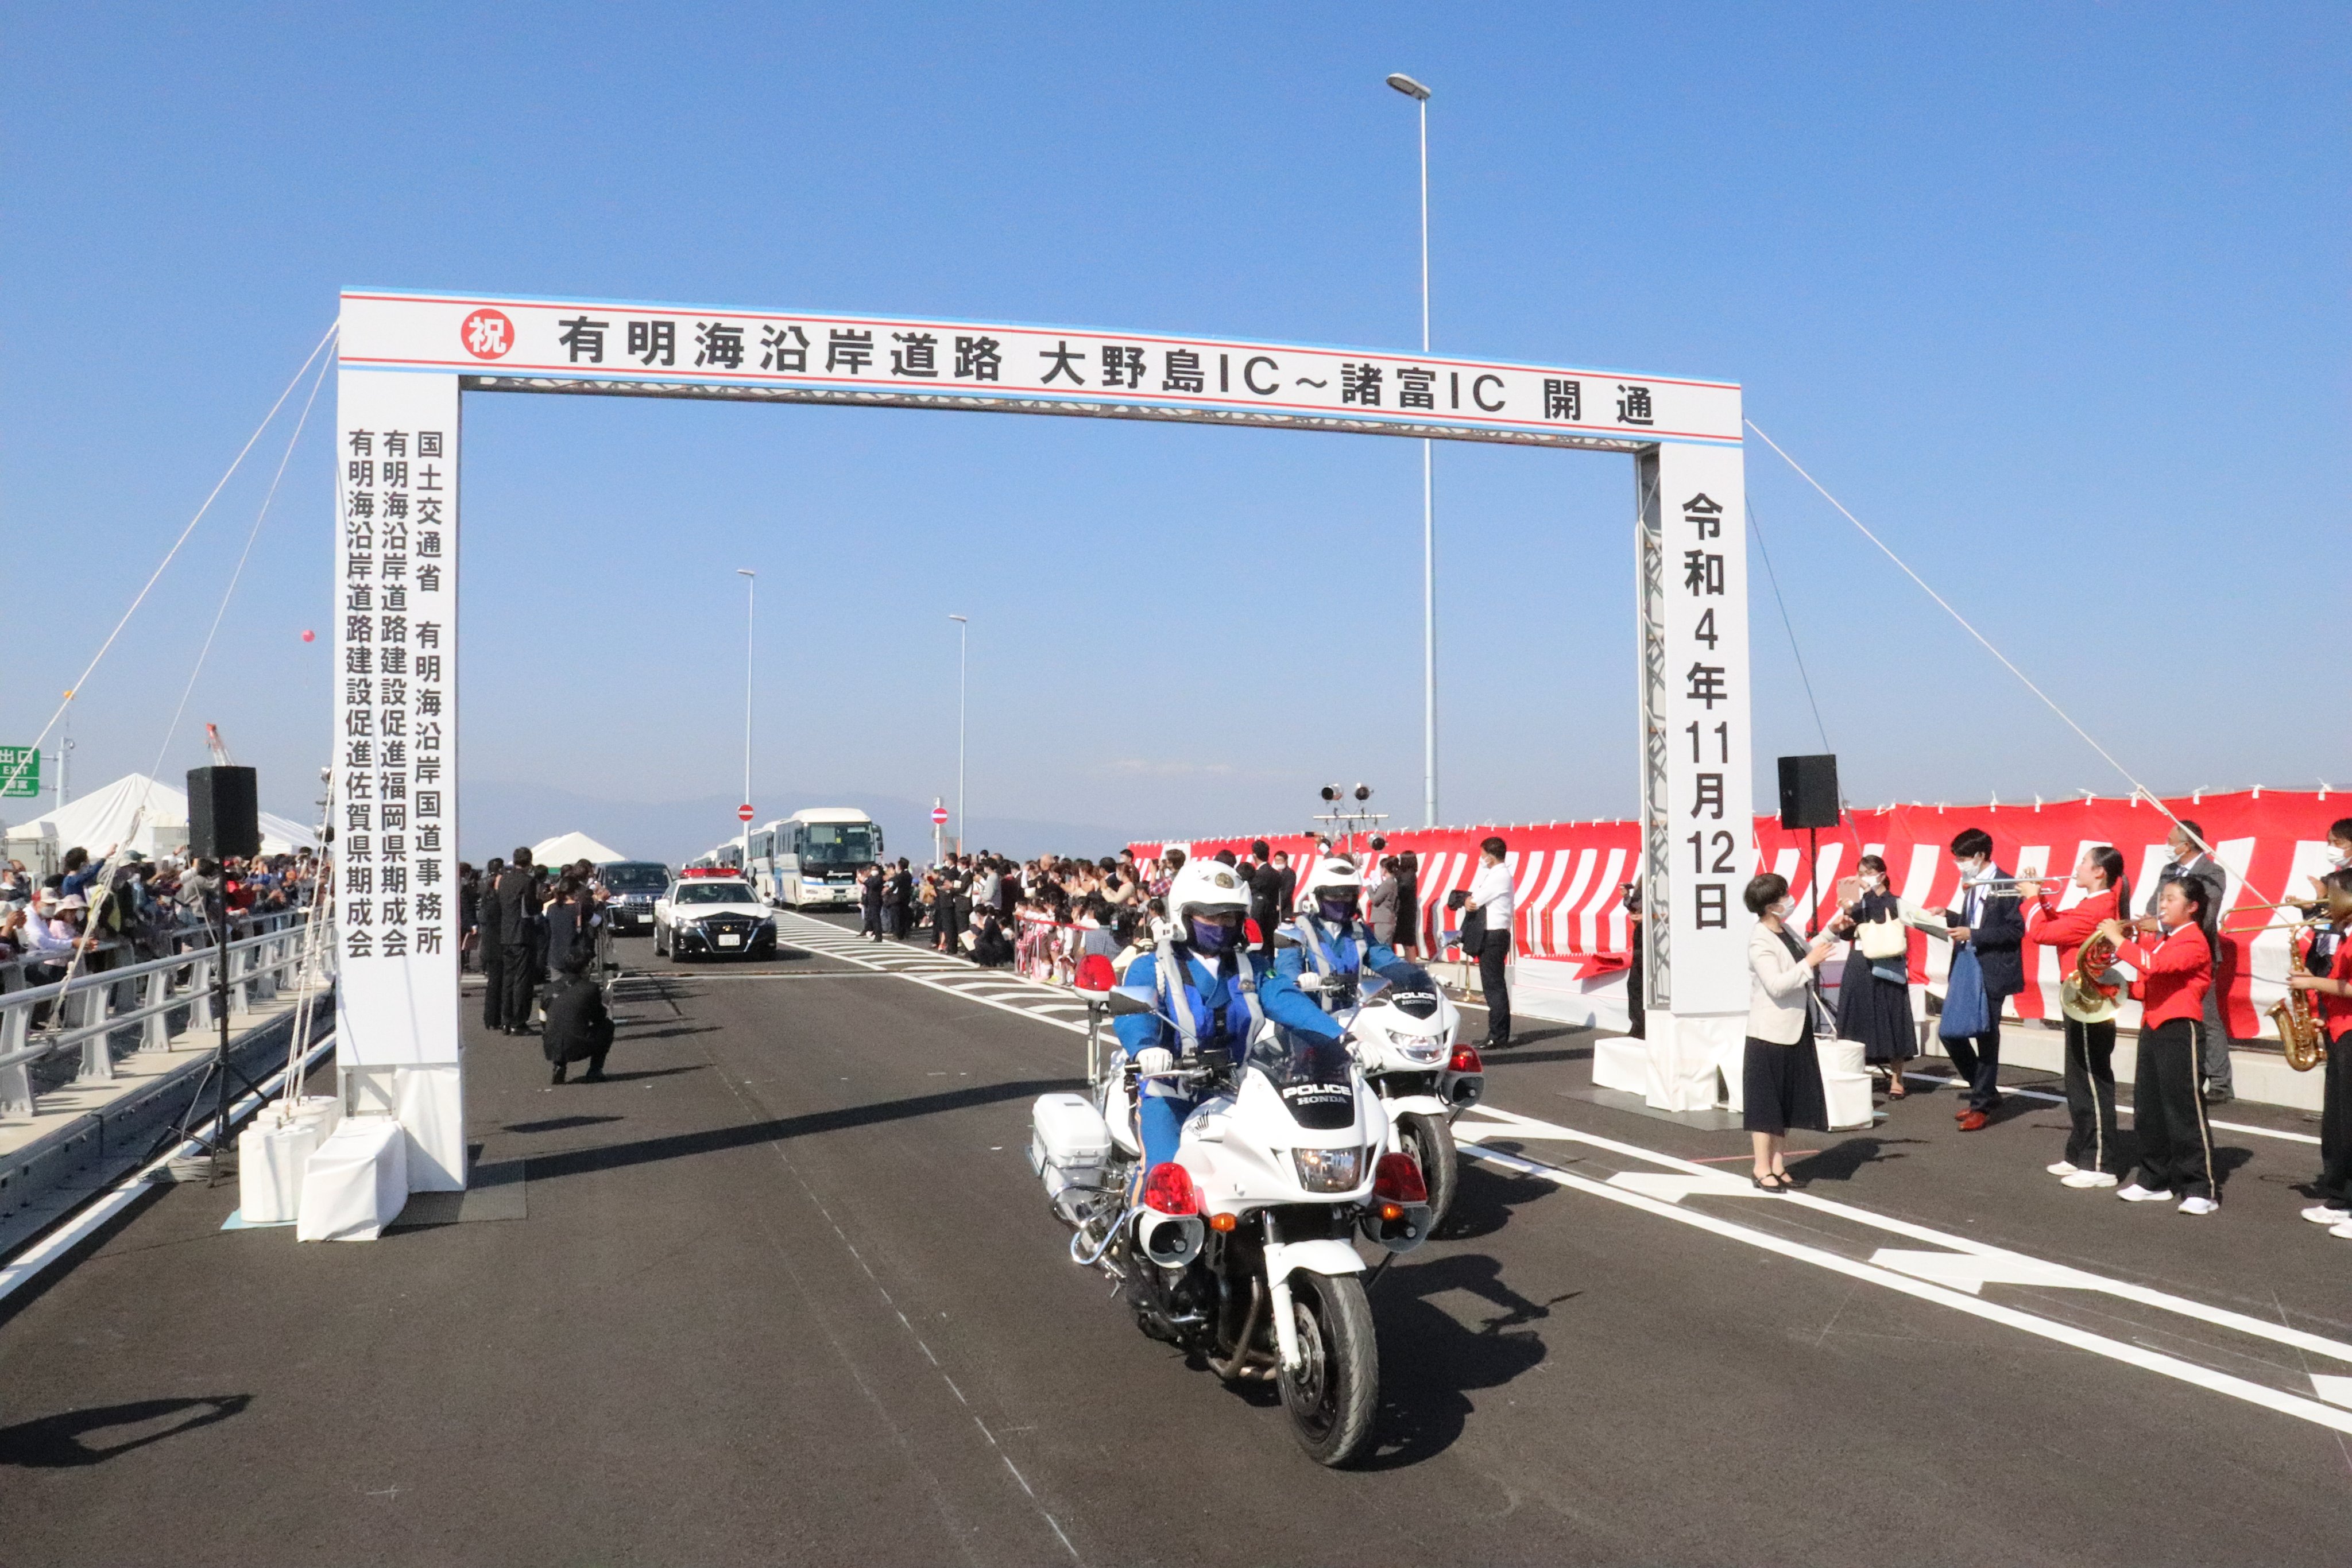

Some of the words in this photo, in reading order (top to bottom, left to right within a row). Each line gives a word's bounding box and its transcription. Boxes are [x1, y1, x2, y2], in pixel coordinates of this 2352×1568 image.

[469, 316, 506, 353] 祝
[558, 316, 1002, 381] 有明海沿岸道路
[1544, 379, 1654, 425] 開通
[416, 431, 443, 592] 国土交通省
[0, 749, 33, 764] 出口
[346, 429, 374, 958] 有明海沿岸道路建設促進佐賀県期成会
[380, 429, 409, 957] 有明海沿岸道路建設促進福岡県期成会
[1682, 492, 1735, 930] 令和4年11月12日
[415, 621, 442, 955] 有明海沿岸国道事務所
[1392, 992, 1437, 1001] POLICE
[1282, 1083, 1352, 1099] POLICE
[1297, 1095, 1347, 1106] HONDA
